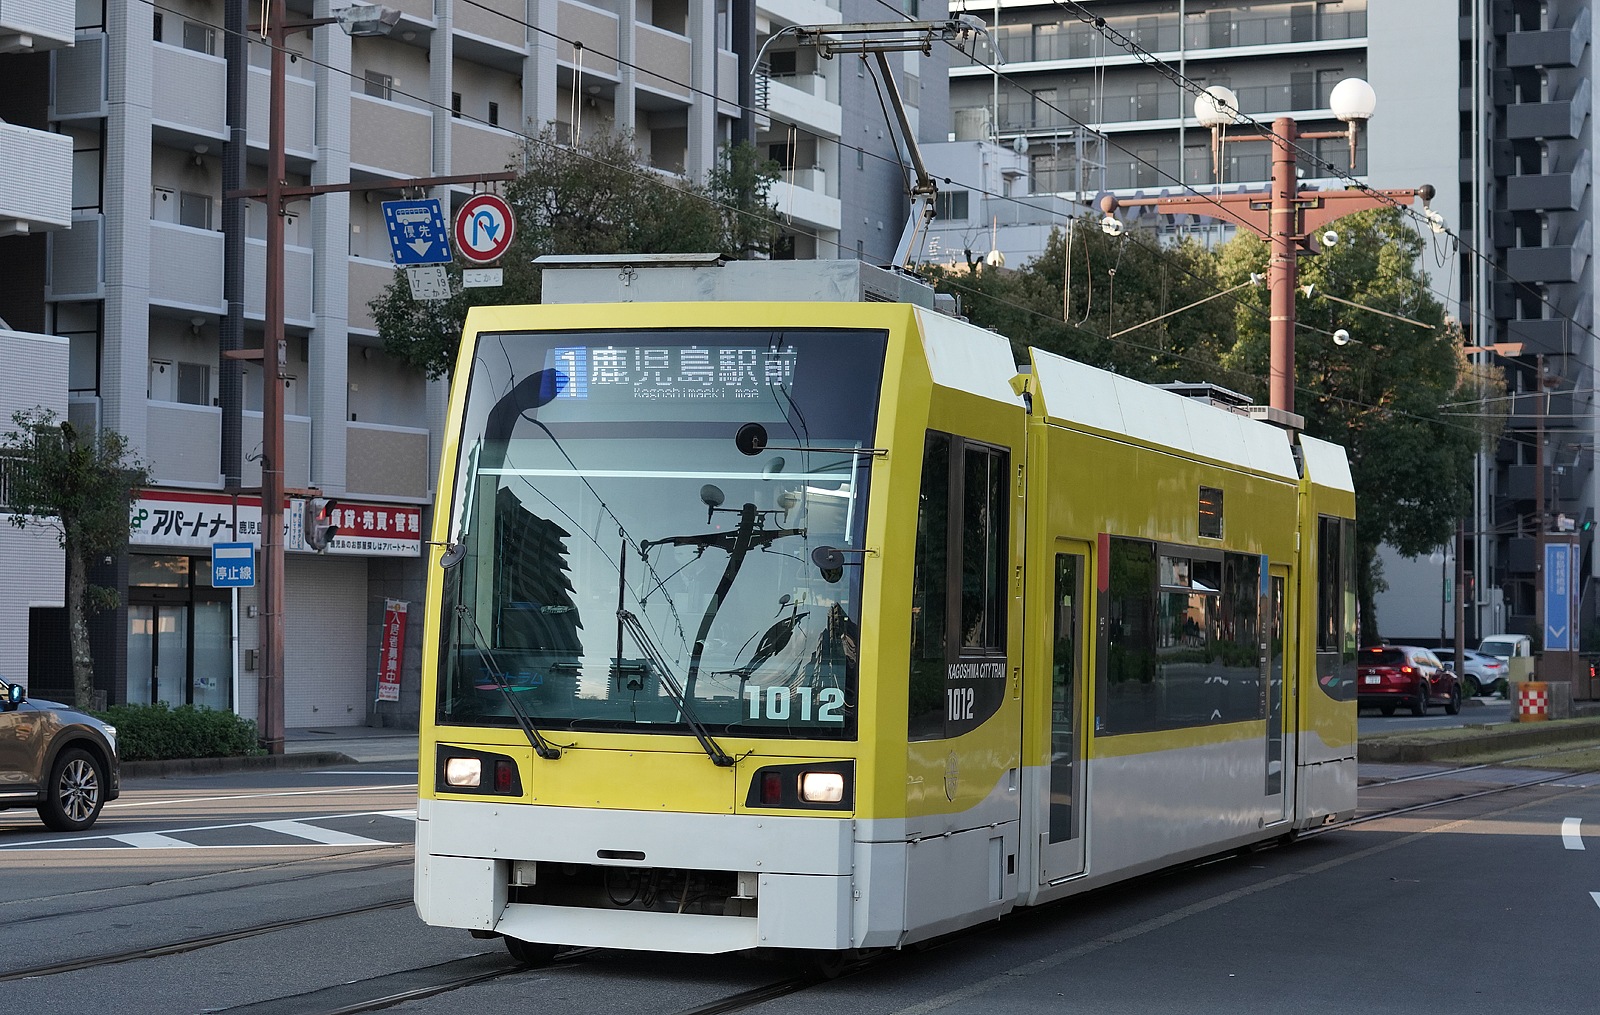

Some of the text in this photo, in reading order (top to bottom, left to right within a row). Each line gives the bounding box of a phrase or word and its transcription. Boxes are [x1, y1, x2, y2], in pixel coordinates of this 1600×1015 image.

[403, 225, 432, 239] 優先
[465, 273, 501, 283] ここから
[414, 288, 450, 298] ここから
[592, 345, 798, 386] 鹿児島駅前
[151, 509, 235, 538] アパートナー
[215, 565, 252, 580] 停止線
[386, 611, 401, 683] 入居者募集中
[947, 663, 1006, 680] KAGOSHIMA CITY TRAM
[744, 686, 845, 722] 1012
[947, 688, 975, 721] 1012
